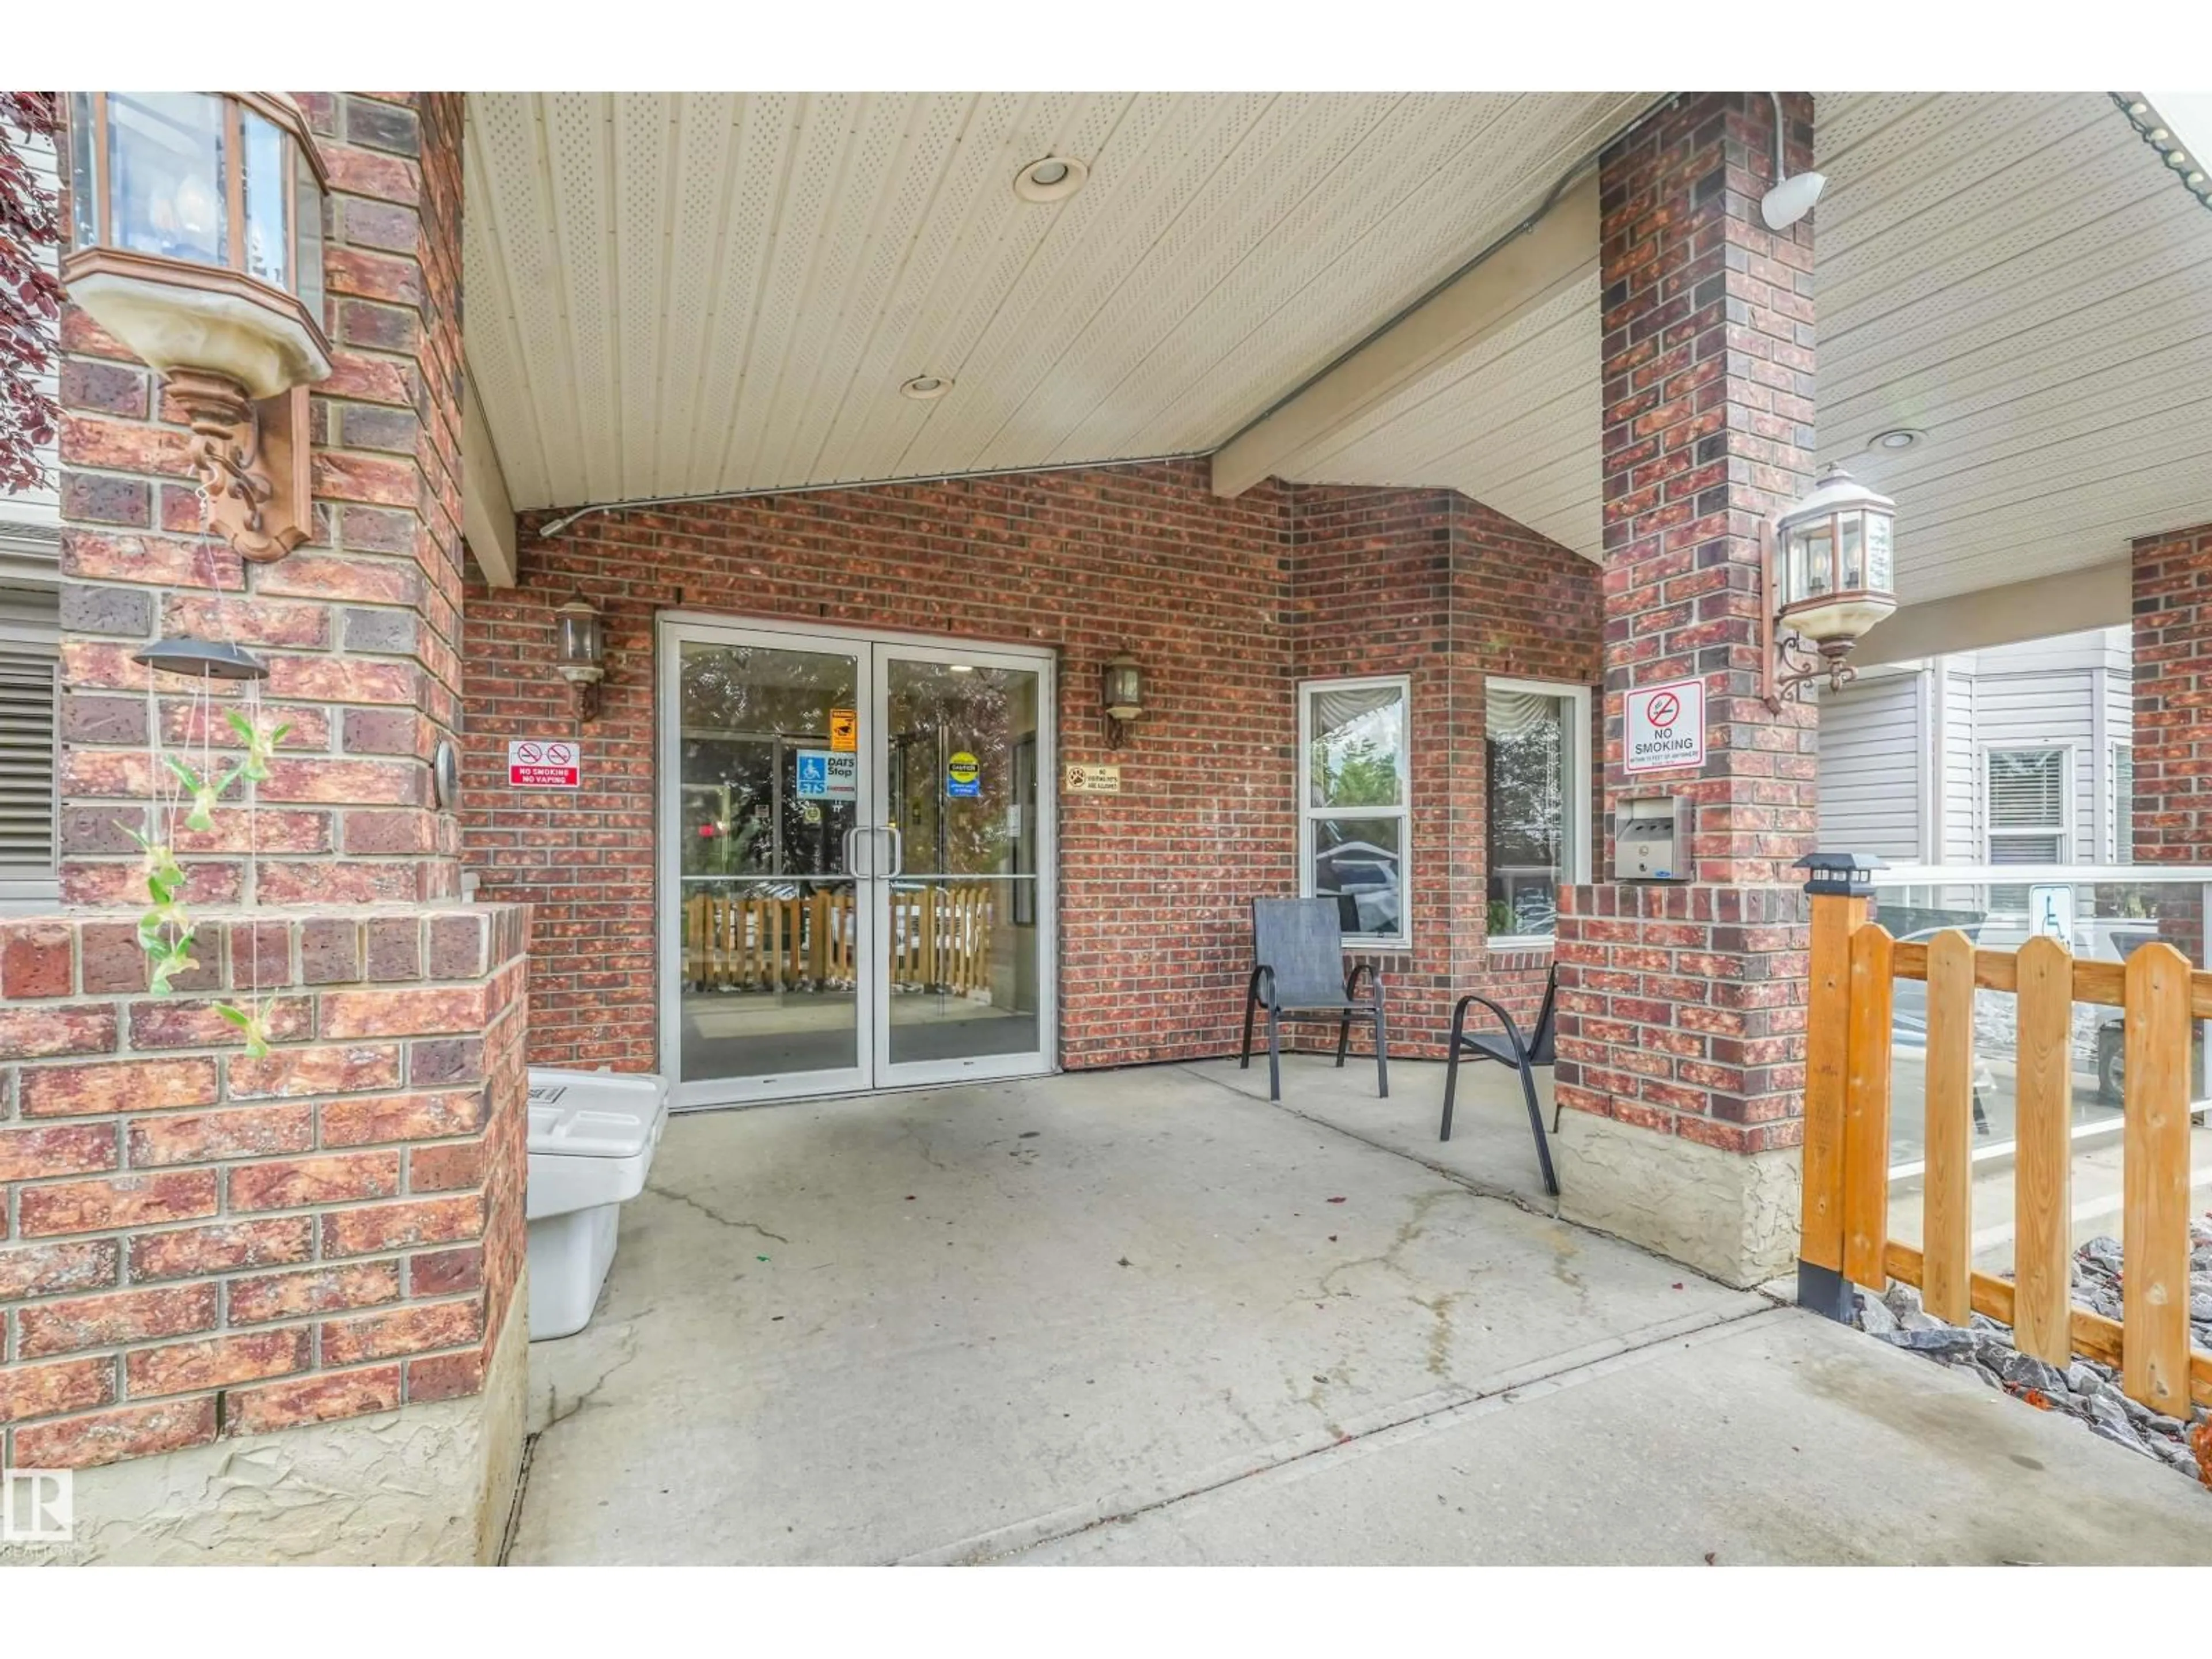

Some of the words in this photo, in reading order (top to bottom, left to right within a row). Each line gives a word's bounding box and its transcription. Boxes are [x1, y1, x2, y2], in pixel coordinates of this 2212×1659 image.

[1654, 728, 1672, 739] NO
[1635, 738, 1694, 755] SMOKING
[828, 757, 855, 767] DATS
[520, 767, 531, 775] NO
[532, 768, 569, 777] SMOKING
[828, 767, 853, 778] Stop
[800, 781, 825, 794] ETS
